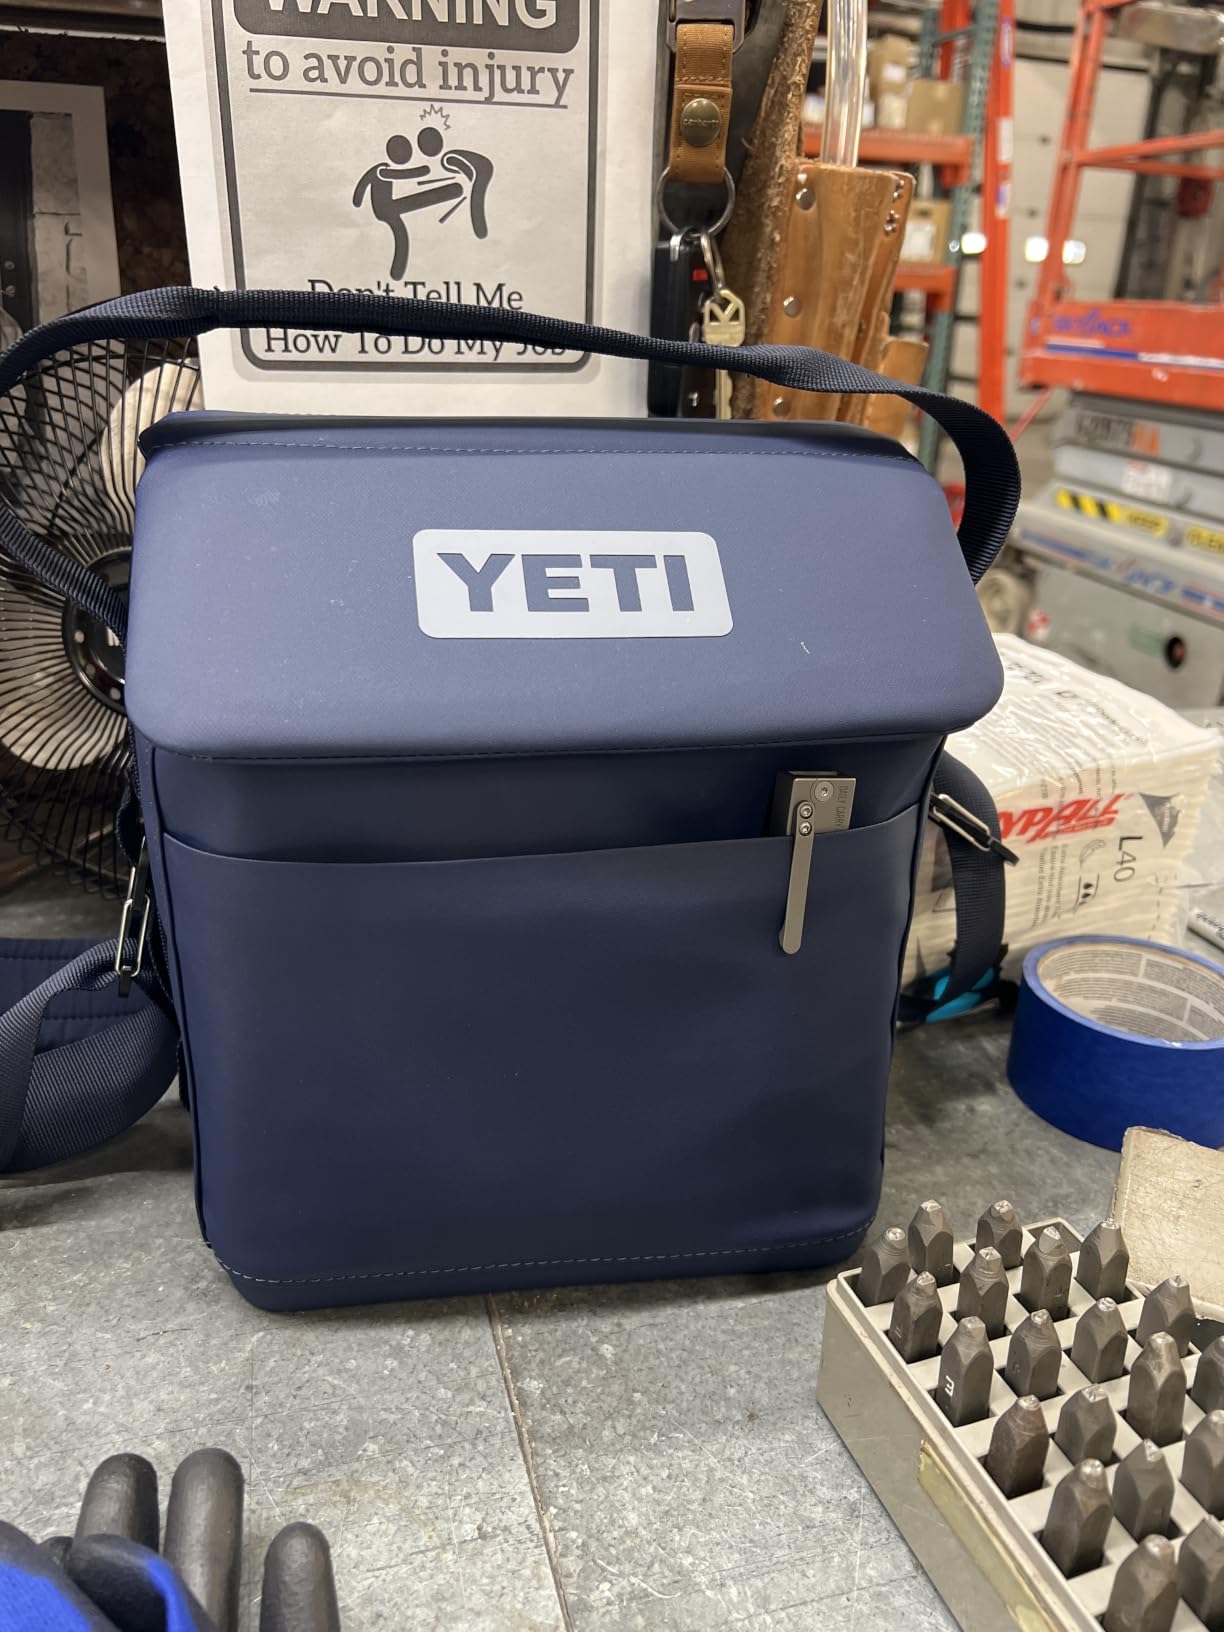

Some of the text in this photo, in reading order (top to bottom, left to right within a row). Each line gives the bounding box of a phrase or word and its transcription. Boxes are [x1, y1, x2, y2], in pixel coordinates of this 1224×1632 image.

[242, 40, 575, 106] to avoid injury
[404, 280, 463, 306] Tell
[472, 282, 524, 310] Me
[264, 327, 343, 354] How
[401, 335, 446, 356] Do
[436, 552, 695, 613] YETI
[833, 806, 846, 827] CARRY
[1113, 836, 1143, 883] L40
